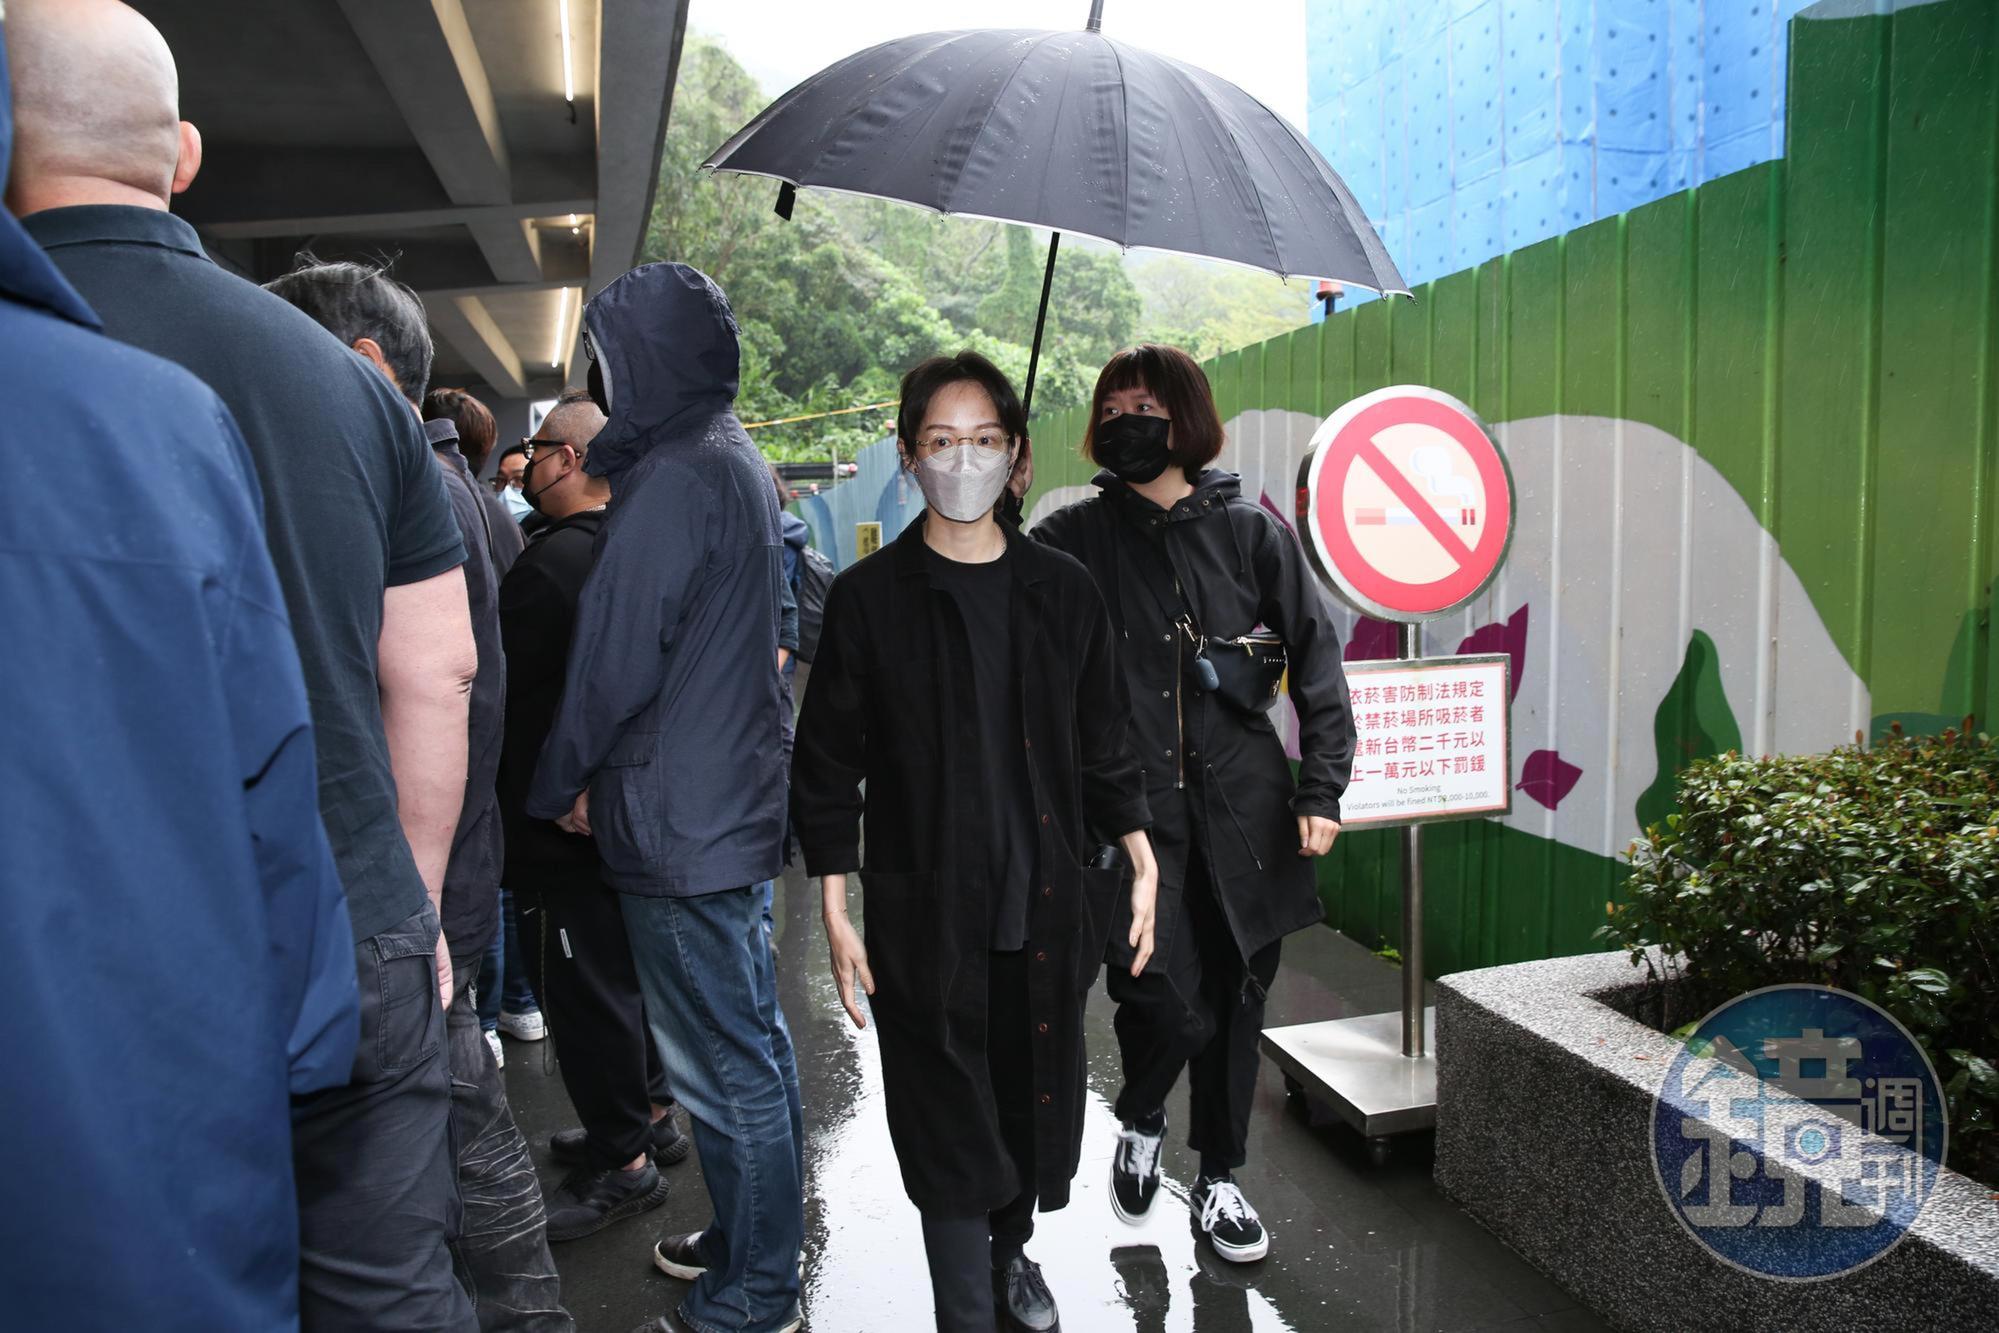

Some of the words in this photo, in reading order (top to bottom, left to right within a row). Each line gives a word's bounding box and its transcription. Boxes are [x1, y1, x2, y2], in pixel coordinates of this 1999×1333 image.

[1397, 787, 1408, 795] No
[1409, 784, 1441, 794] Smoking
[1347, 801, 1380, 811] Violators
[1381, 799, 1395, 808] will
[1396, 798, 1406, 807] be
[1407, 796, 1426, 806] fined
